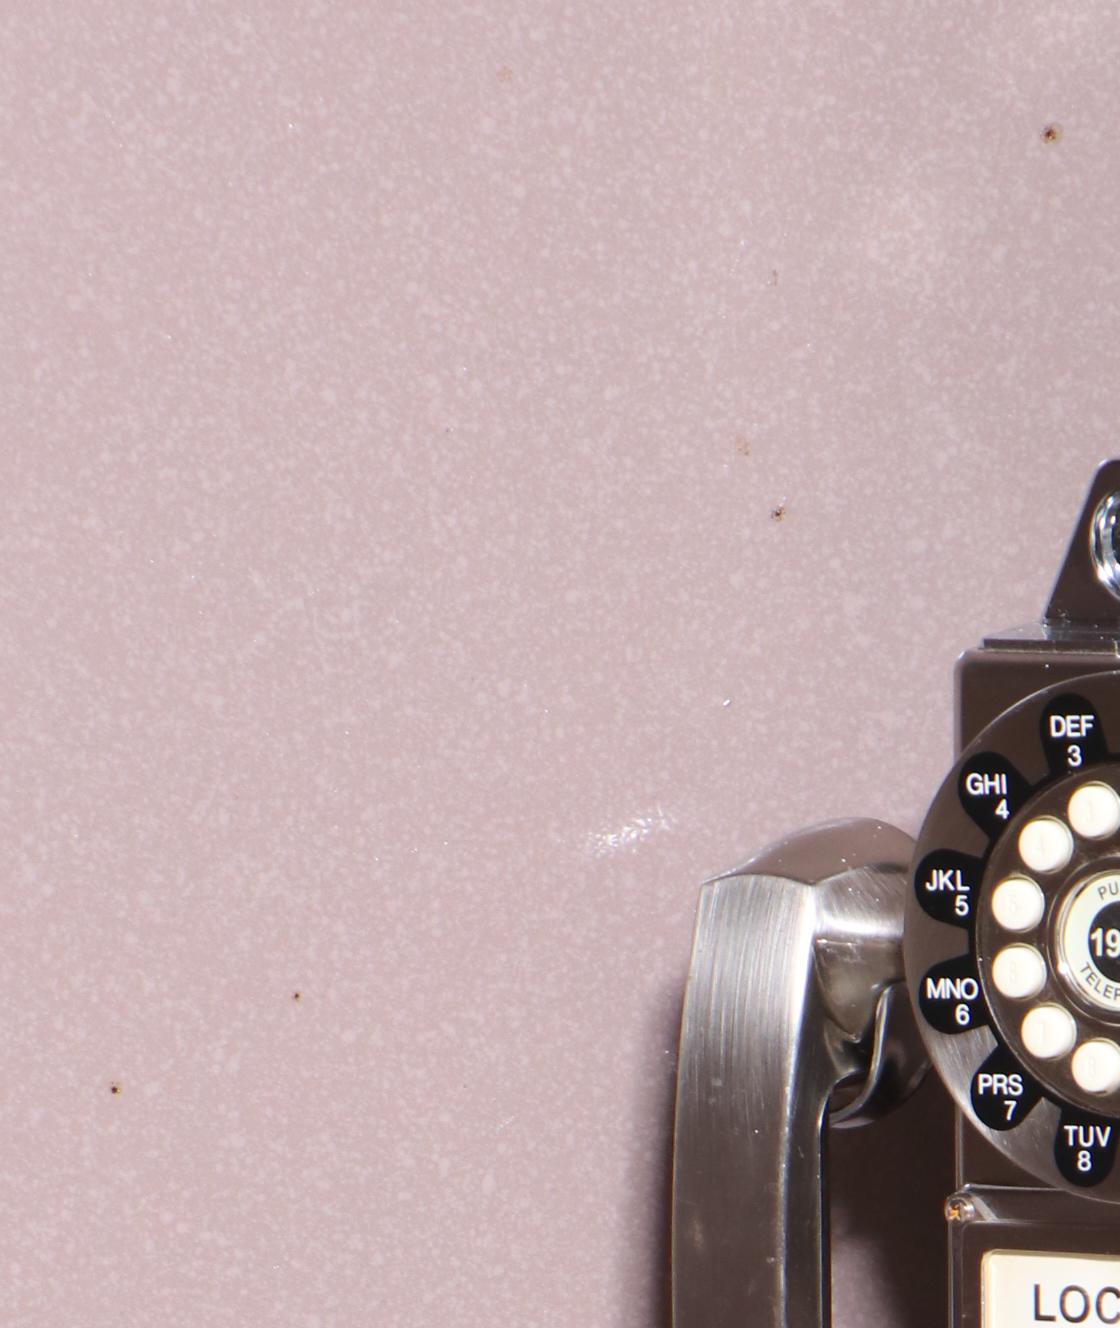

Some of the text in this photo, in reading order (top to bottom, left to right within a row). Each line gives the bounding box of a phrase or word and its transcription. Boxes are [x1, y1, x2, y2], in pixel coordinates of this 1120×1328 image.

[1051, 715, 1094, 737] DEF
[1068, 745, 1081, 765] 3
[966, 773, 1006, 795] GHI
[996, 799, 1009, 819] 4
[926, 870, 969, 891] JKL
[956, 895, 968, 915] 5
[927, 978, 978, 999] MNO
[956, 1004, 969, 1025] 6
[979, 1074, 1023, 1095] PRS
[1004, 1101, 1016, 1120] 7
[1064, 1126, 1110, 1147] TUV
[1078, 1151, 1091, 1171] 8
